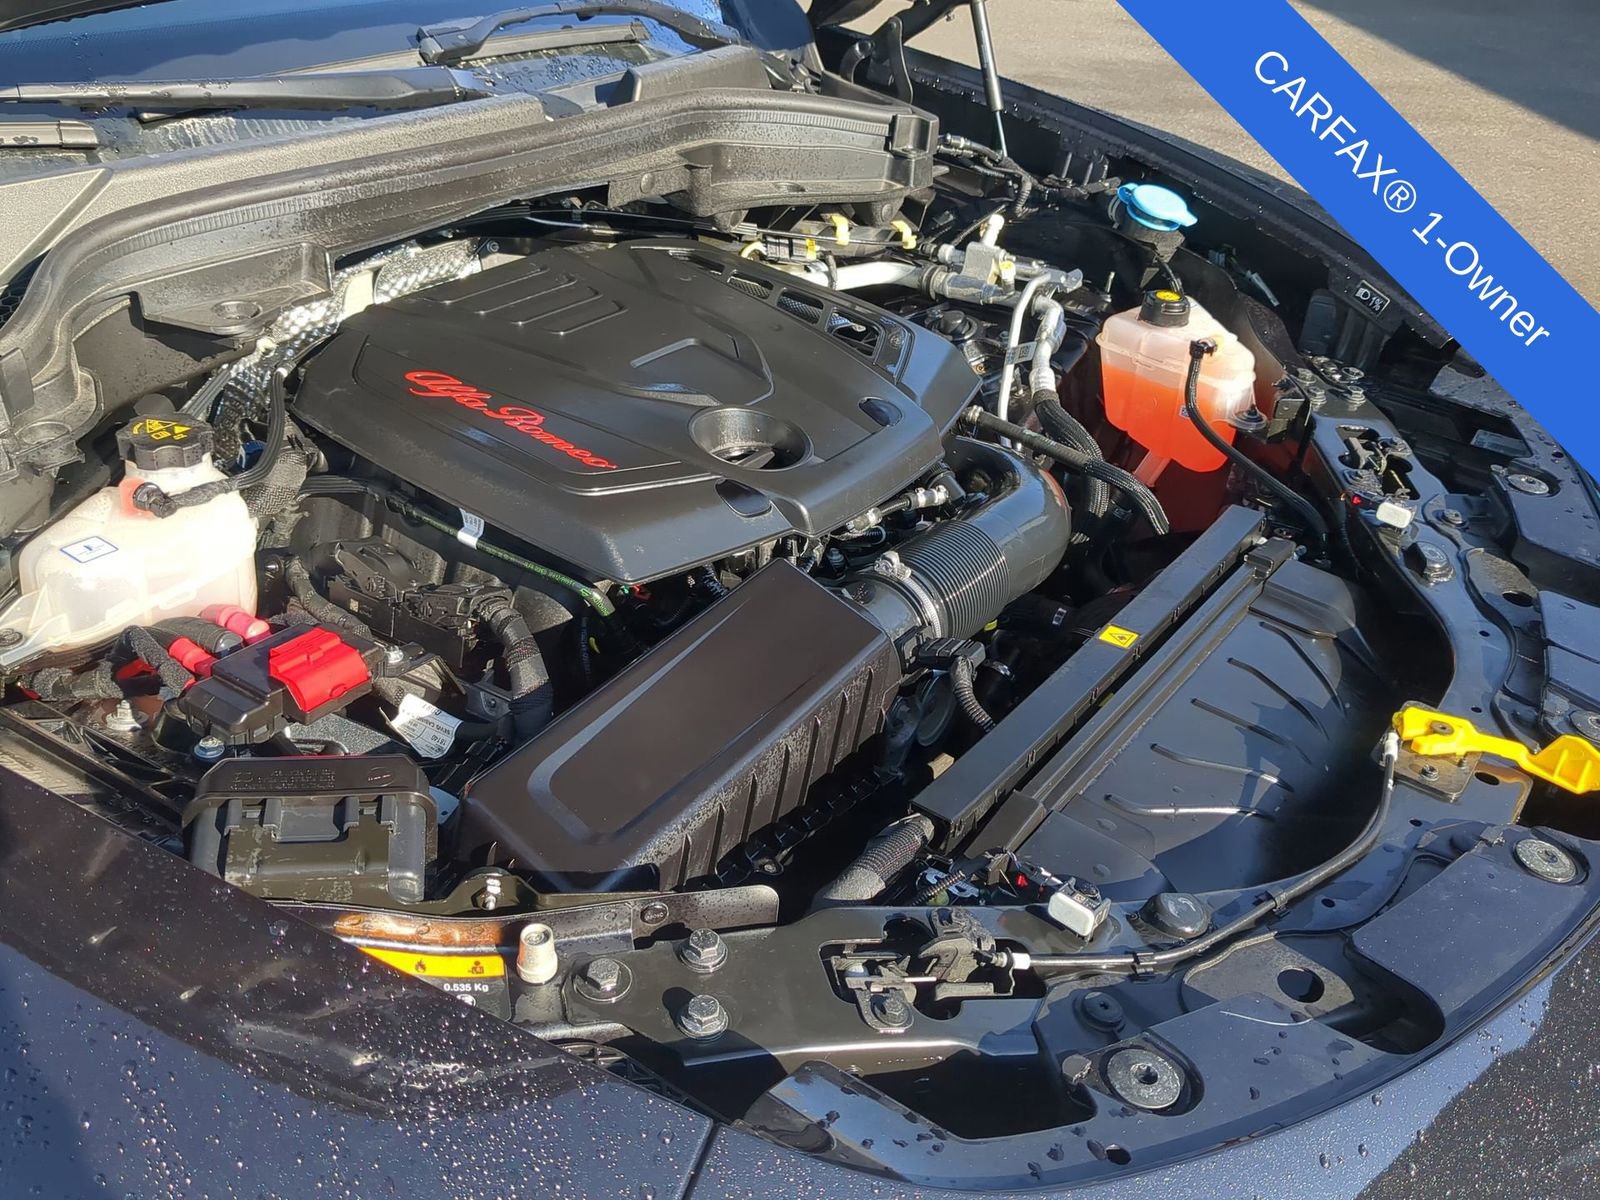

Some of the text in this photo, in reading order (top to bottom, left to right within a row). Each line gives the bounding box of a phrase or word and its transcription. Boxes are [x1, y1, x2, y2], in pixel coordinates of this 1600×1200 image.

[404, 370, 618, 469] Alfa Romeo
[443, 983, 489, 993] 0.535 Kg
